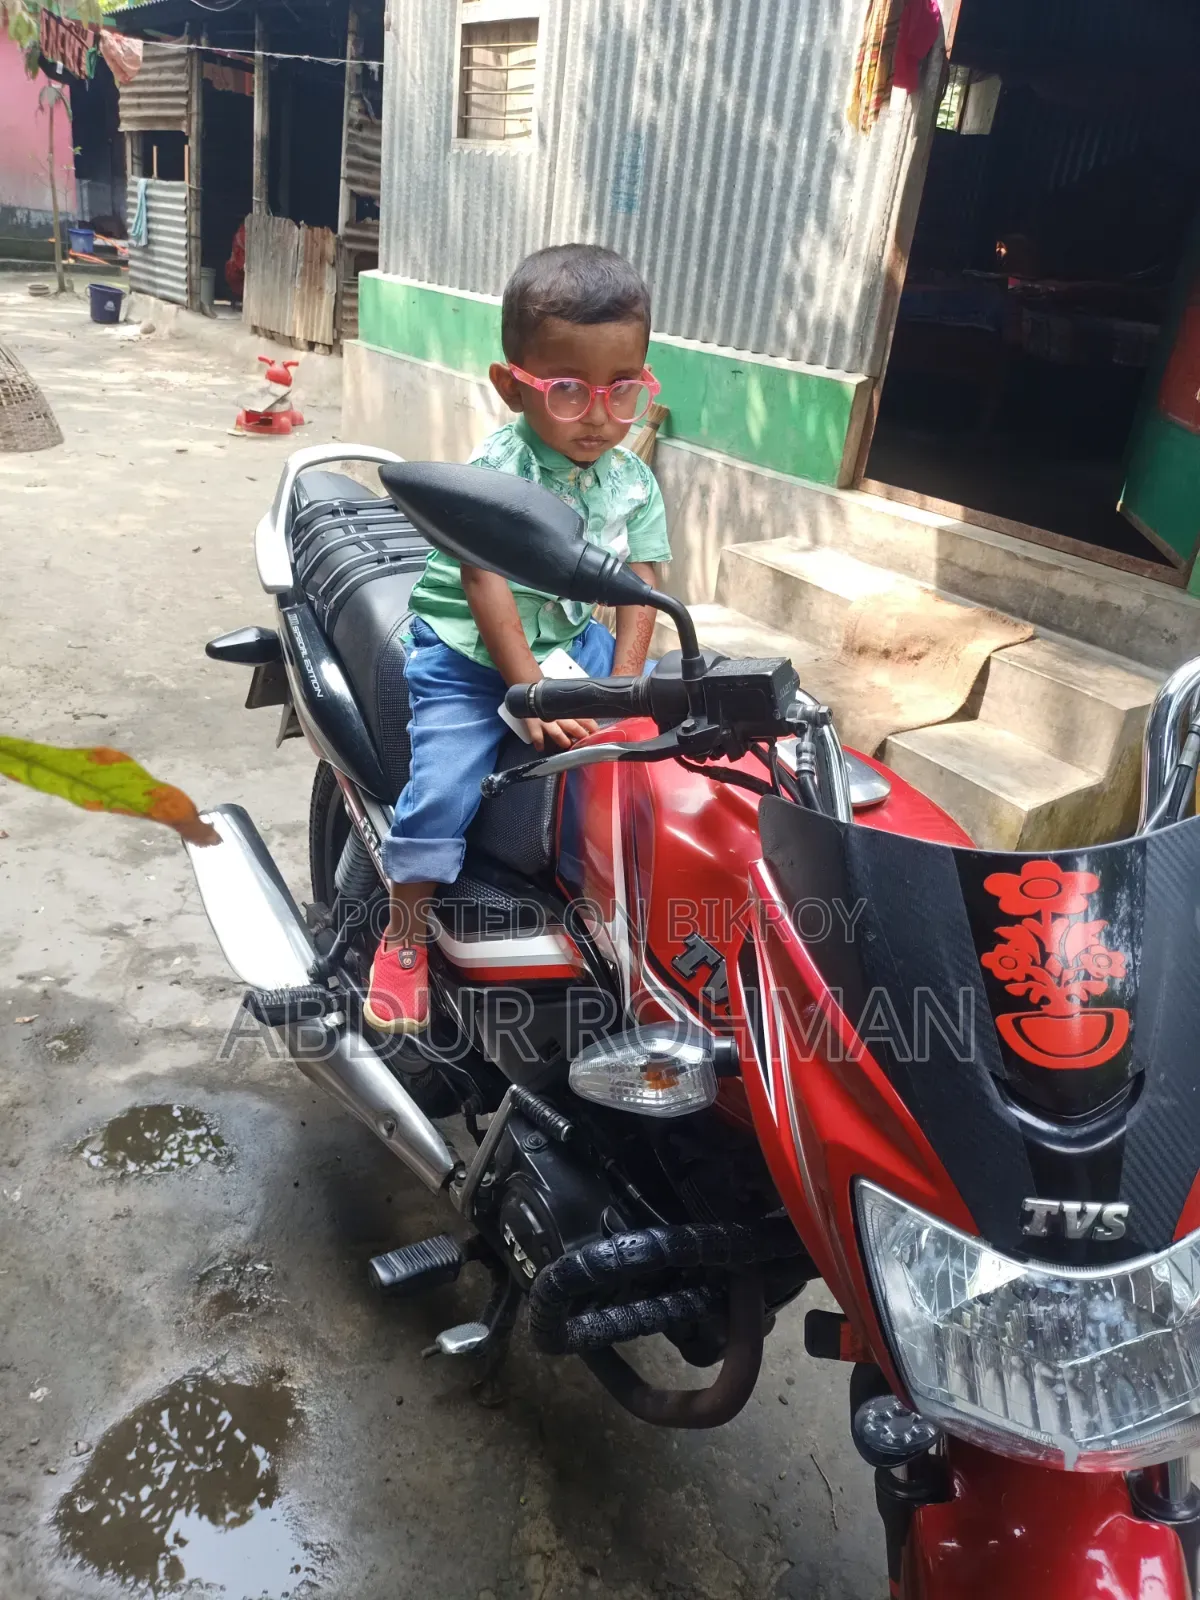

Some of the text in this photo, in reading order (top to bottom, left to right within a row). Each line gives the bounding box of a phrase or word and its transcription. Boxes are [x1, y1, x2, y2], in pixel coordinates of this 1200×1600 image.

[292, 625, 308, 658] SPECIAL
[304, 658, 324, 698] EDITION
[671, 932, 732, 1016] TV
[503, 1222, 537, 1279] TVS
[1021, 1198, 1130, 1241] TVS
